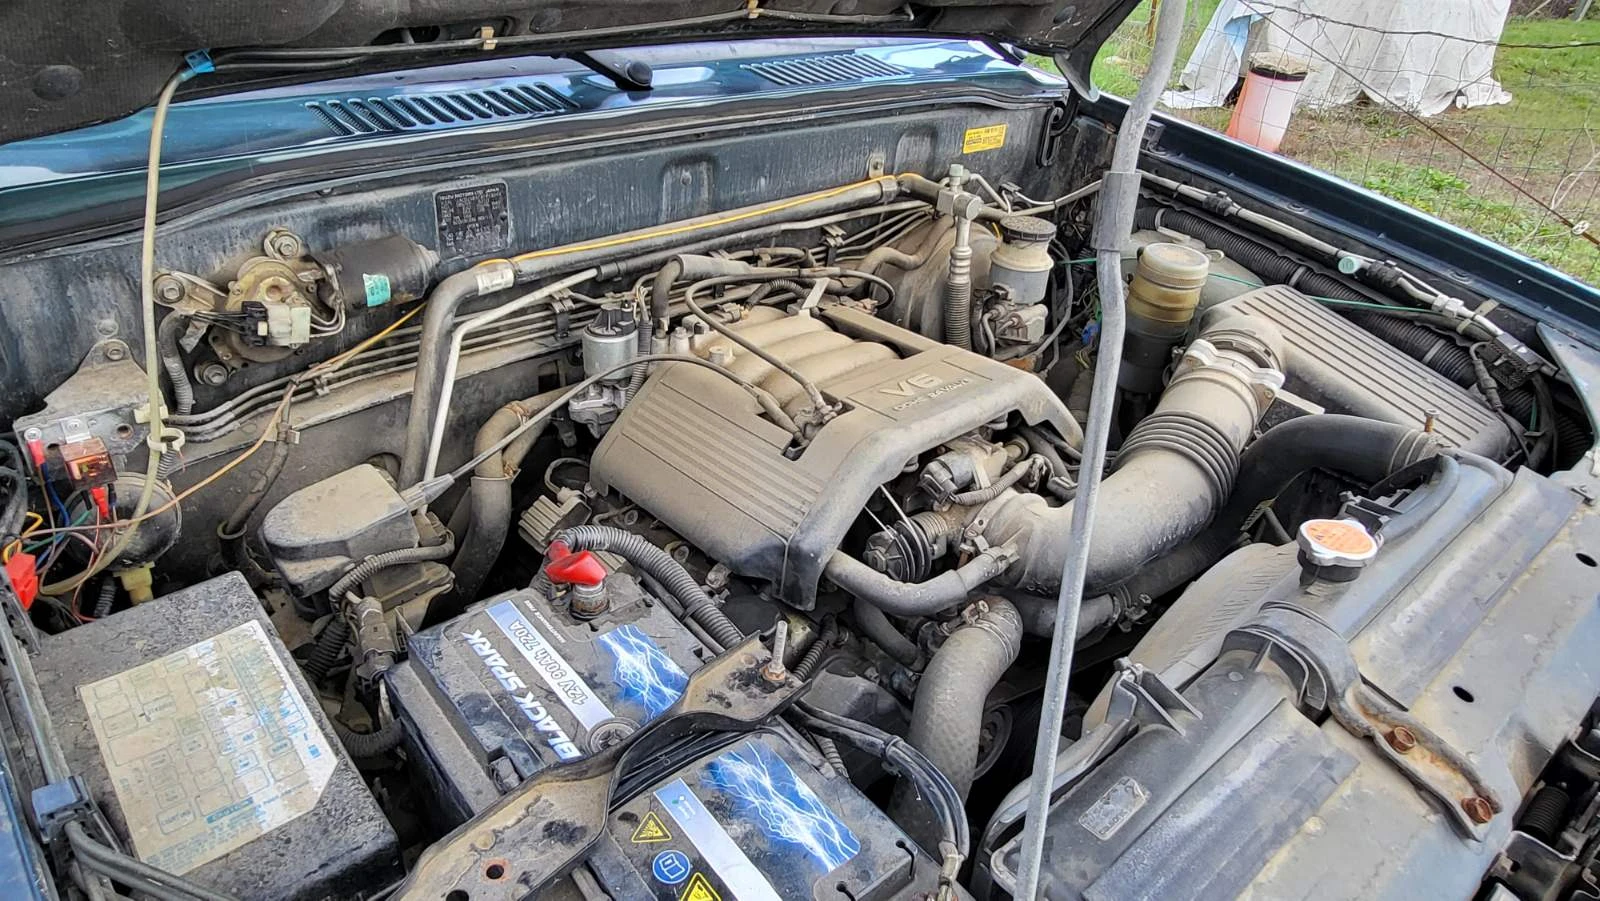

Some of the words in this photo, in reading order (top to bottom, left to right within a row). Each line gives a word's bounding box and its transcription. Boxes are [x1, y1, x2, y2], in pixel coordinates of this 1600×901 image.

[879, 373, 943, 397] V6
[507, 619, 541, 652] 720A
[460, 629, 528, 692] SPARK
[534, 647, 568, 680] 90Ah
[557, 679, 589, 706] 12V
[512, 691, 583, 764] BLACK
